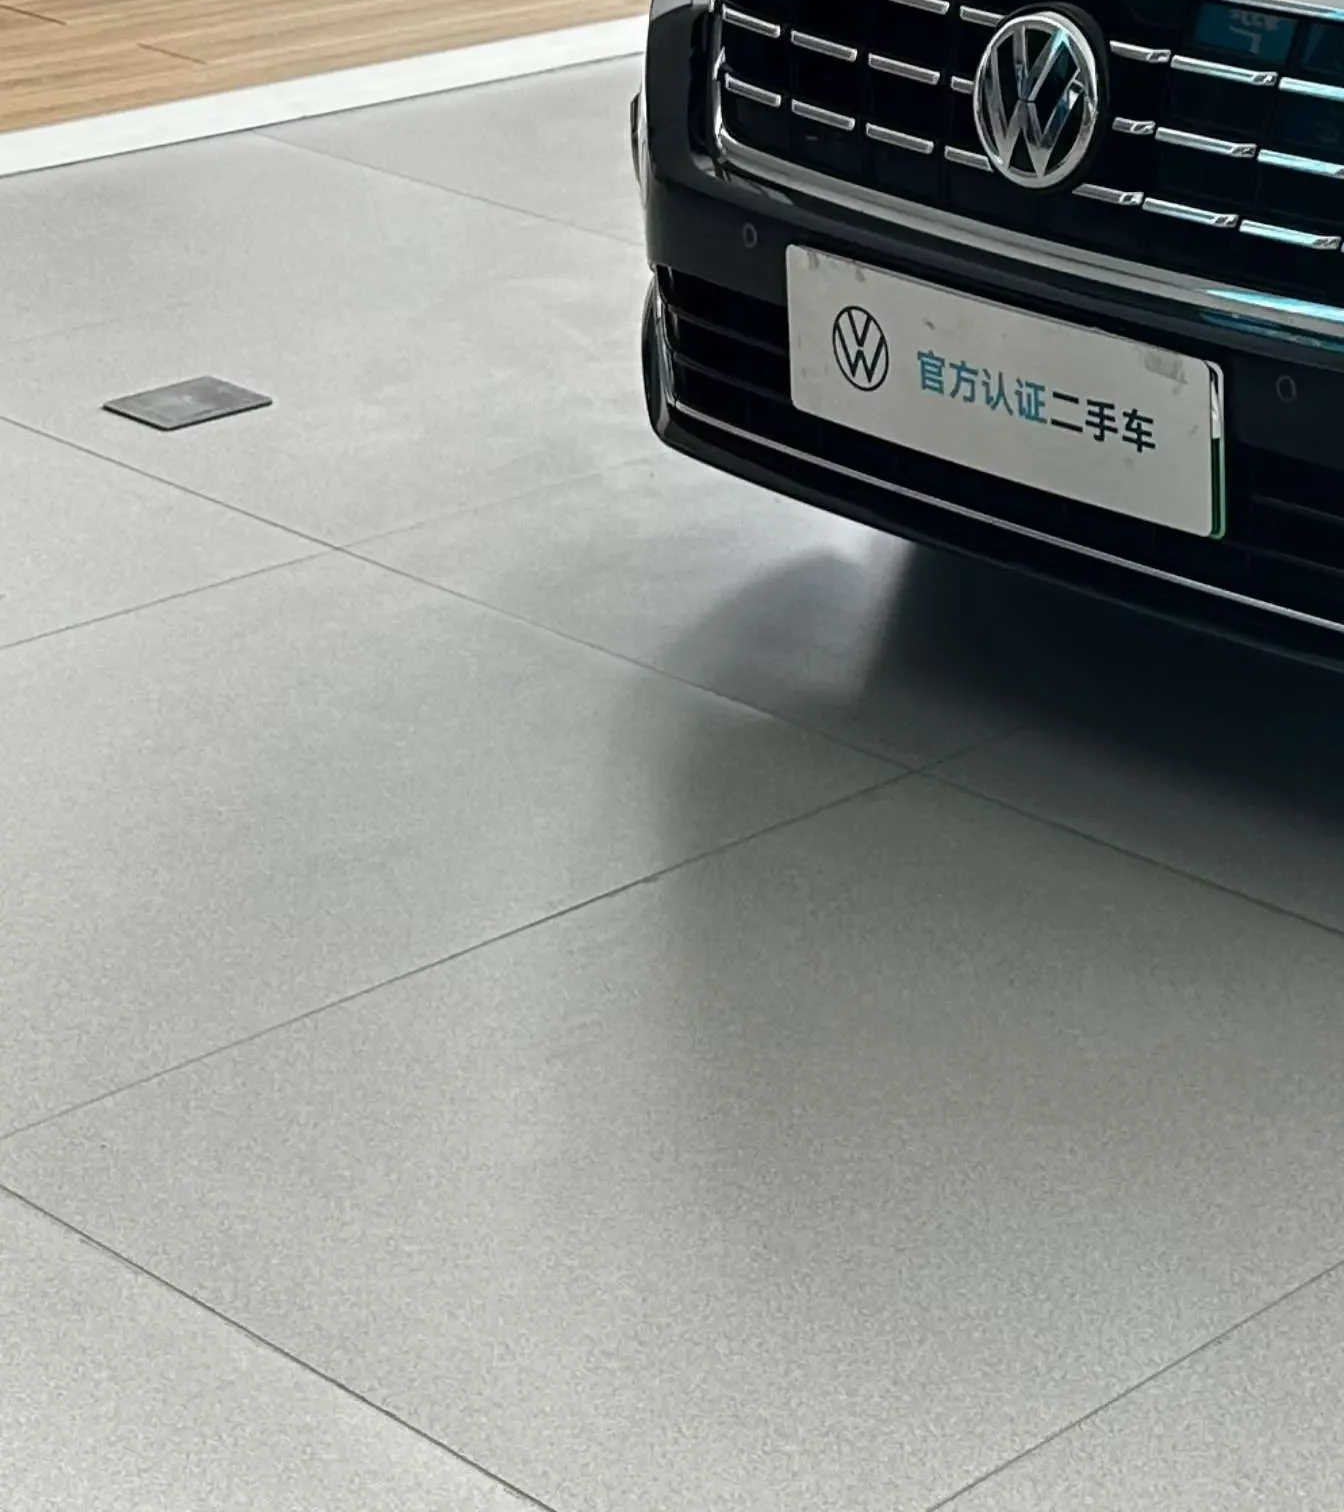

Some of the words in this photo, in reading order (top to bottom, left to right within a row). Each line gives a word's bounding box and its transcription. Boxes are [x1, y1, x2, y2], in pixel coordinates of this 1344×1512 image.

[916, 348, 1157, 454] 官方认证二手车
